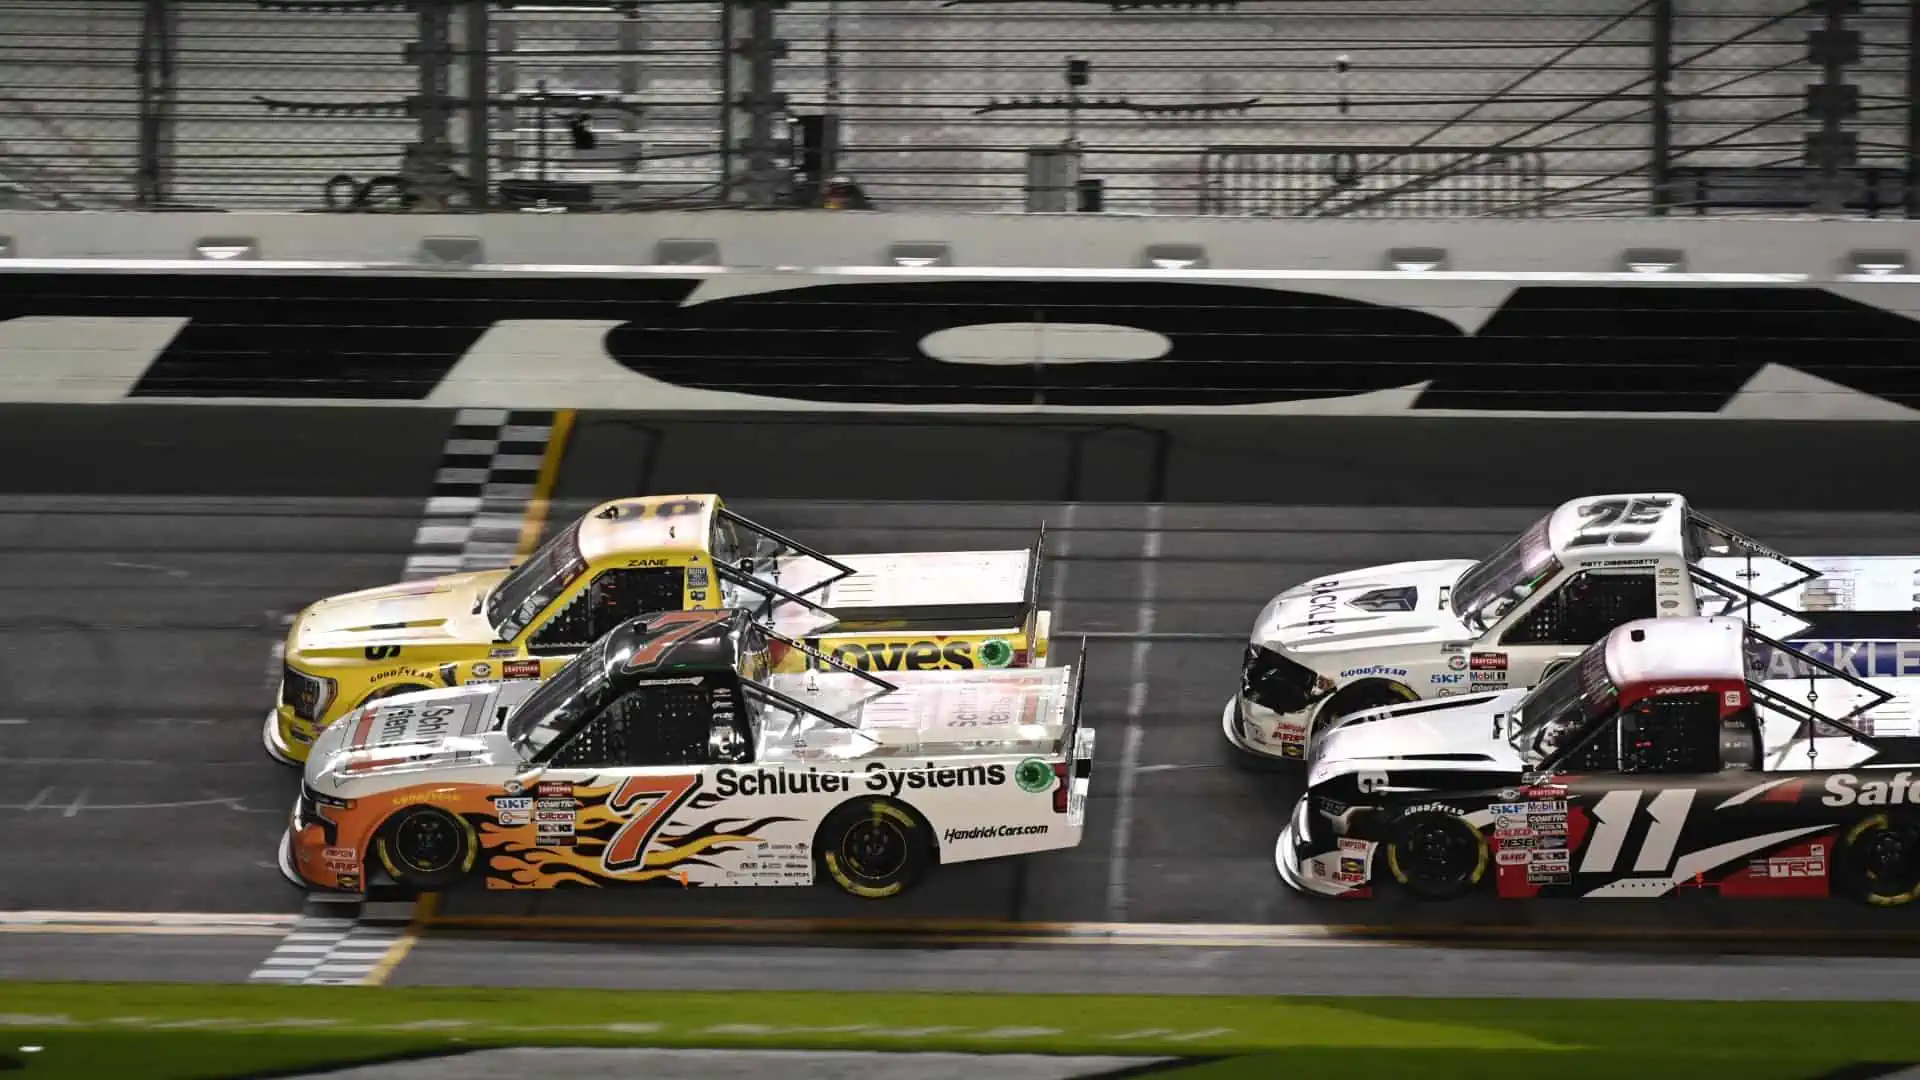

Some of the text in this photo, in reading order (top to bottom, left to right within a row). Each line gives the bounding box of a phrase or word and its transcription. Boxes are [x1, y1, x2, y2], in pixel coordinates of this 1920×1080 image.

[1562, 498, 1673, 549] 25
[627, 558, 669, 567] ZANE
[1308, 580, 1340, 635] RACKLEY
[620, 610, 732, 674] 7
[369, 665, 434, 684] GOODYEAR
[1340, 664, 1407, 679] GOODYEAR
[1430, 673, 1464, 684] SKF
[1469, 671, 1496, 682] Mobil
[715, 758, 1006, 798] Schluter Systems
[495, 799, 531, 809] SKF
[1404, 801, 1465, 816] GOODYEAR
[1490, 804, 1526, 815] SKF
[1527, 802, 1554, 812] Mobil
[600, 773, 704, 874] 7
[1578, 788, 1697, 874] 11
[1339, 839, 1368, 849] SIMPSON
[1530, 864, 1567, 872] tilton
[1769, 861, 1824, 875] TRD
[1331, 871, 1364, 882] ARP
